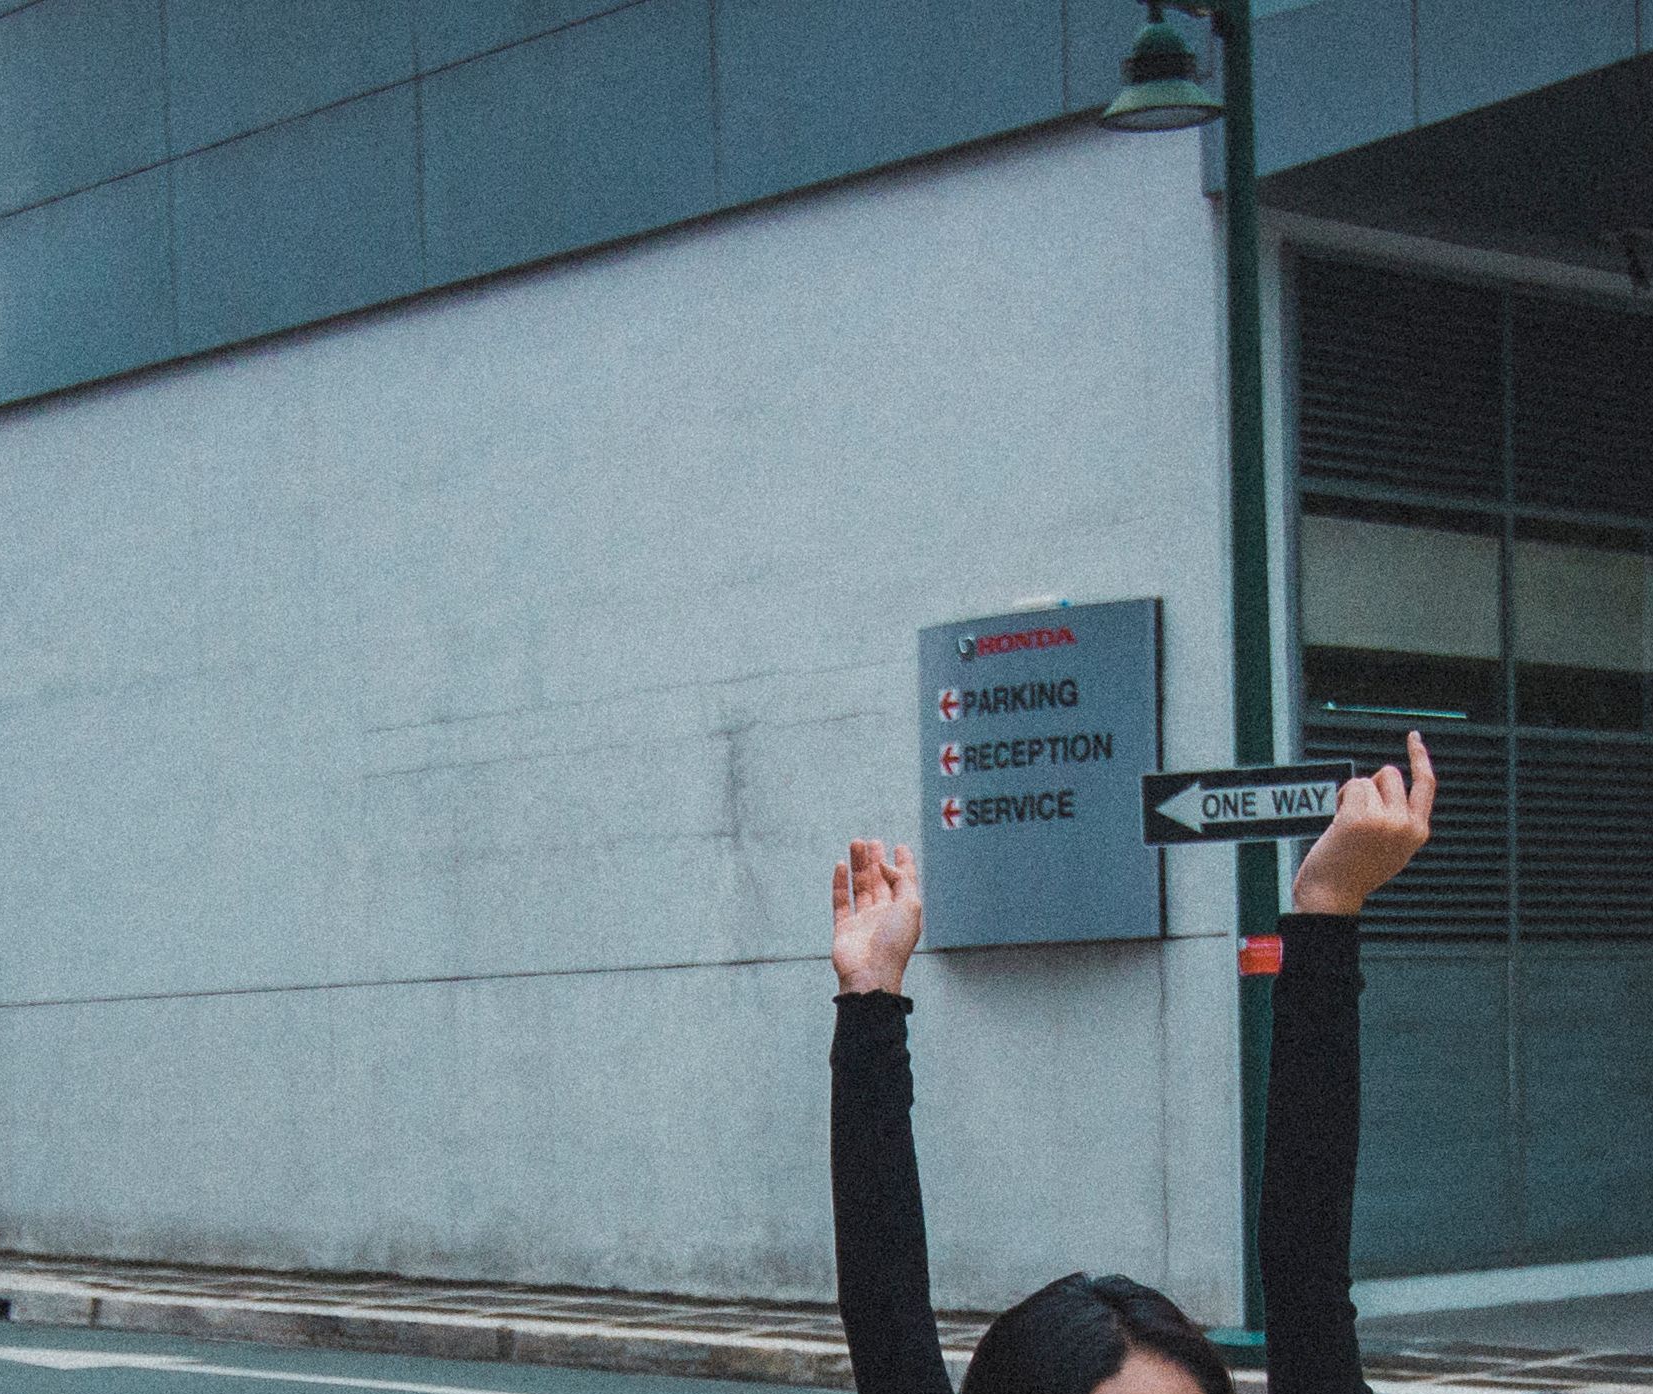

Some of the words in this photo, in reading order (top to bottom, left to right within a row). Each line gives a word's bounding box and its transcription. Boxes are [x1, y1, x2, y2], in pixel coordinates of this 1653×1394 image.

[976, 626, 1077, 657] HONDA
[962, 679, 1079, 717] PARKING
[963, 733, 1113, 775] RECEPTION
[965, 790, 1075, 827] SERVICE
[1201, 791, 1257, 820] ONE
[1271, 786, 1329, 815] WAY
